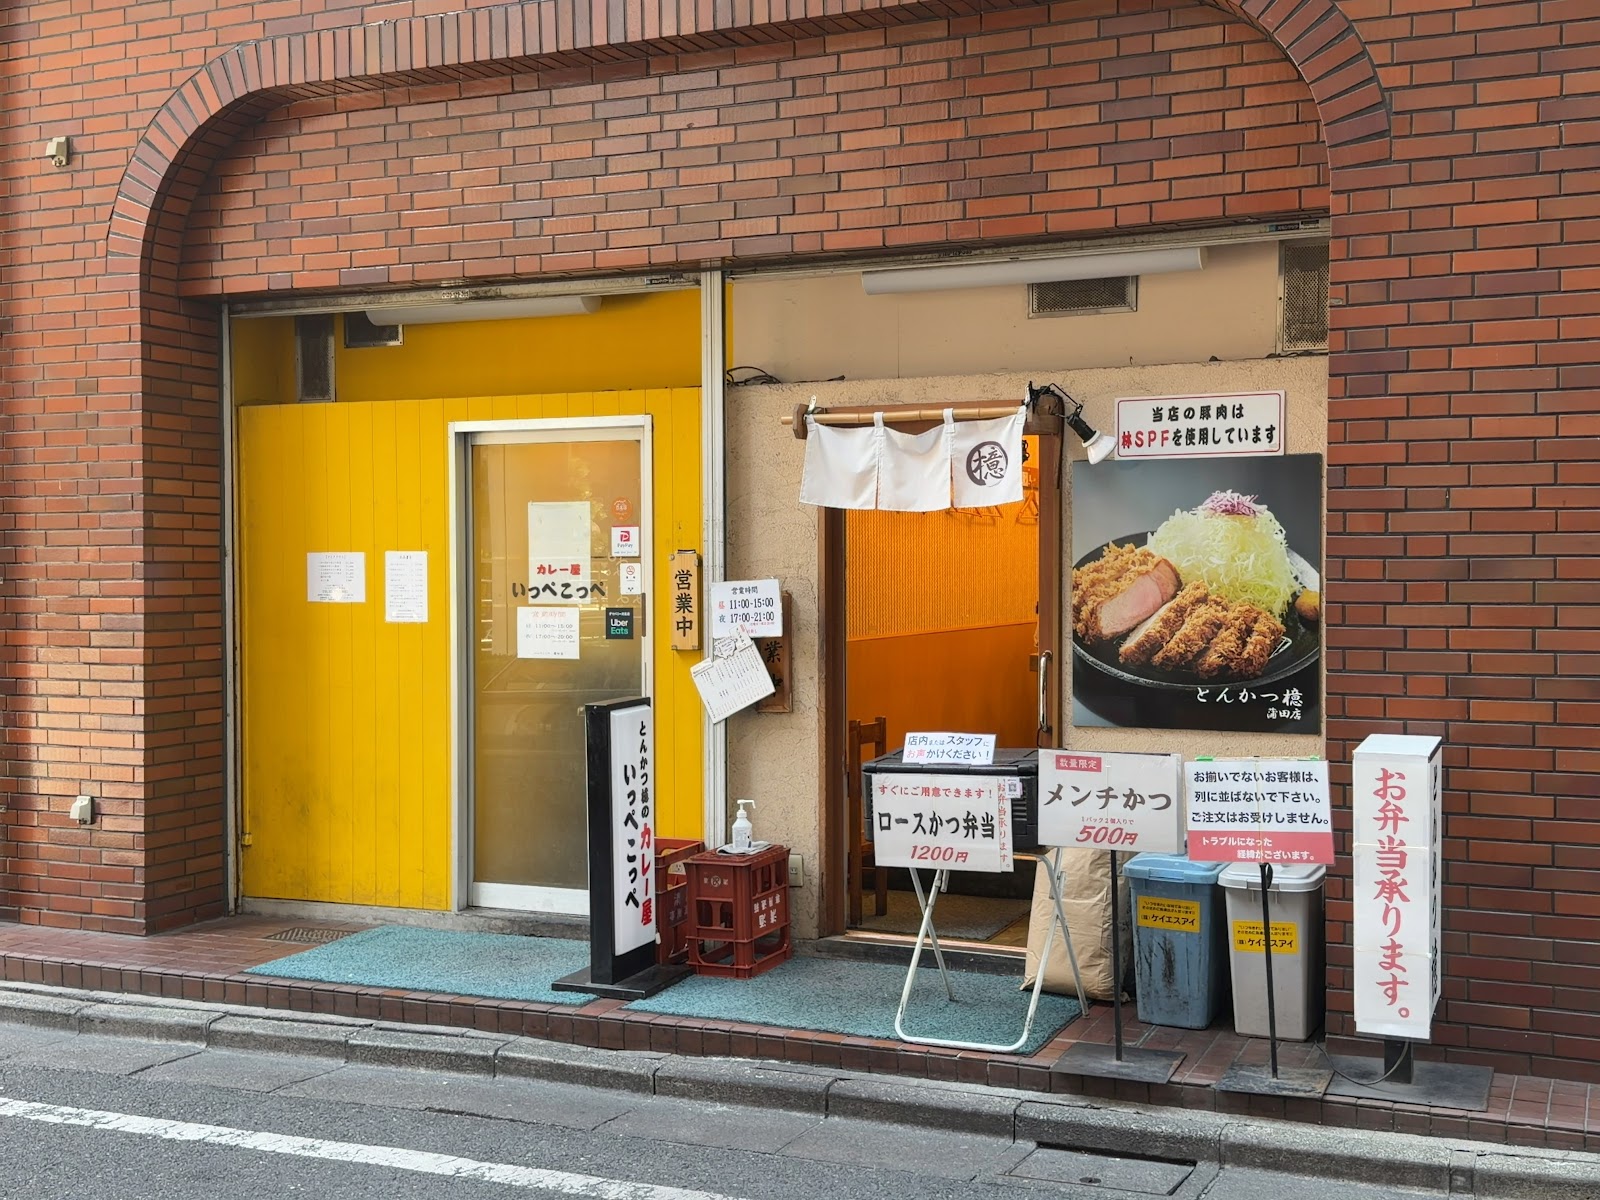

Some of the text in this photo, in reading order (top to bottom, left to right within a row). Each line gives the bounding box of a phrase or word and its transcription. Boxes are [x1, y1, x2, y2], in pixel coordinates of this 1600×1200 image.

[1152, 403, 1244, 423] 当店の豚肉は
[1121, 424, 1276, 449] 林SPFを使用しています
[536, 563, 581, 576] カレー屋
[512, 581, 606, 600] いっぺこっぺ
[731, 586, 759, 595] 営業時間
[674, 569, 695, 638] 営業中
[729, 597, 774, 610] 11:00-15:00
[610, 619, 629, 628] Uber
[719, 614, 726, 623] 夜
[730, 611, 775, 624] 17:00-21:00
[610, 627, 629, 635] Eats
[1196, 687, 1304, 707] とんかつ檍
[1266, 706, 1302, 721] 蒲田店
[907, 735, 990, 748] 店内またはスタッフに
[1059, 758, 1098, 770] 数量限定
[1193, 770, 1320, 784] お揃いでないお客様は、
[878, 783, 993, 799] すぐにご用意できます！
[1043, 783, 1172, 811] メンチかつ
[1194, 791, 1321, 804] 列に並ばないで下さい。
[877, 810, 995, 840] ロースかつ弁当
[1191, 811, 1329, 825] ご注文はお受けしません。
[623, 764, 640, 909] いっぺこっぺ
[1075, 825, 1139, 846] 500円
[1202, 836, 1273, 847] トラブルになった
[910, 845, 969, 864] 1200円
[1372, 767, 1411, 1019] お弁当承ります。
